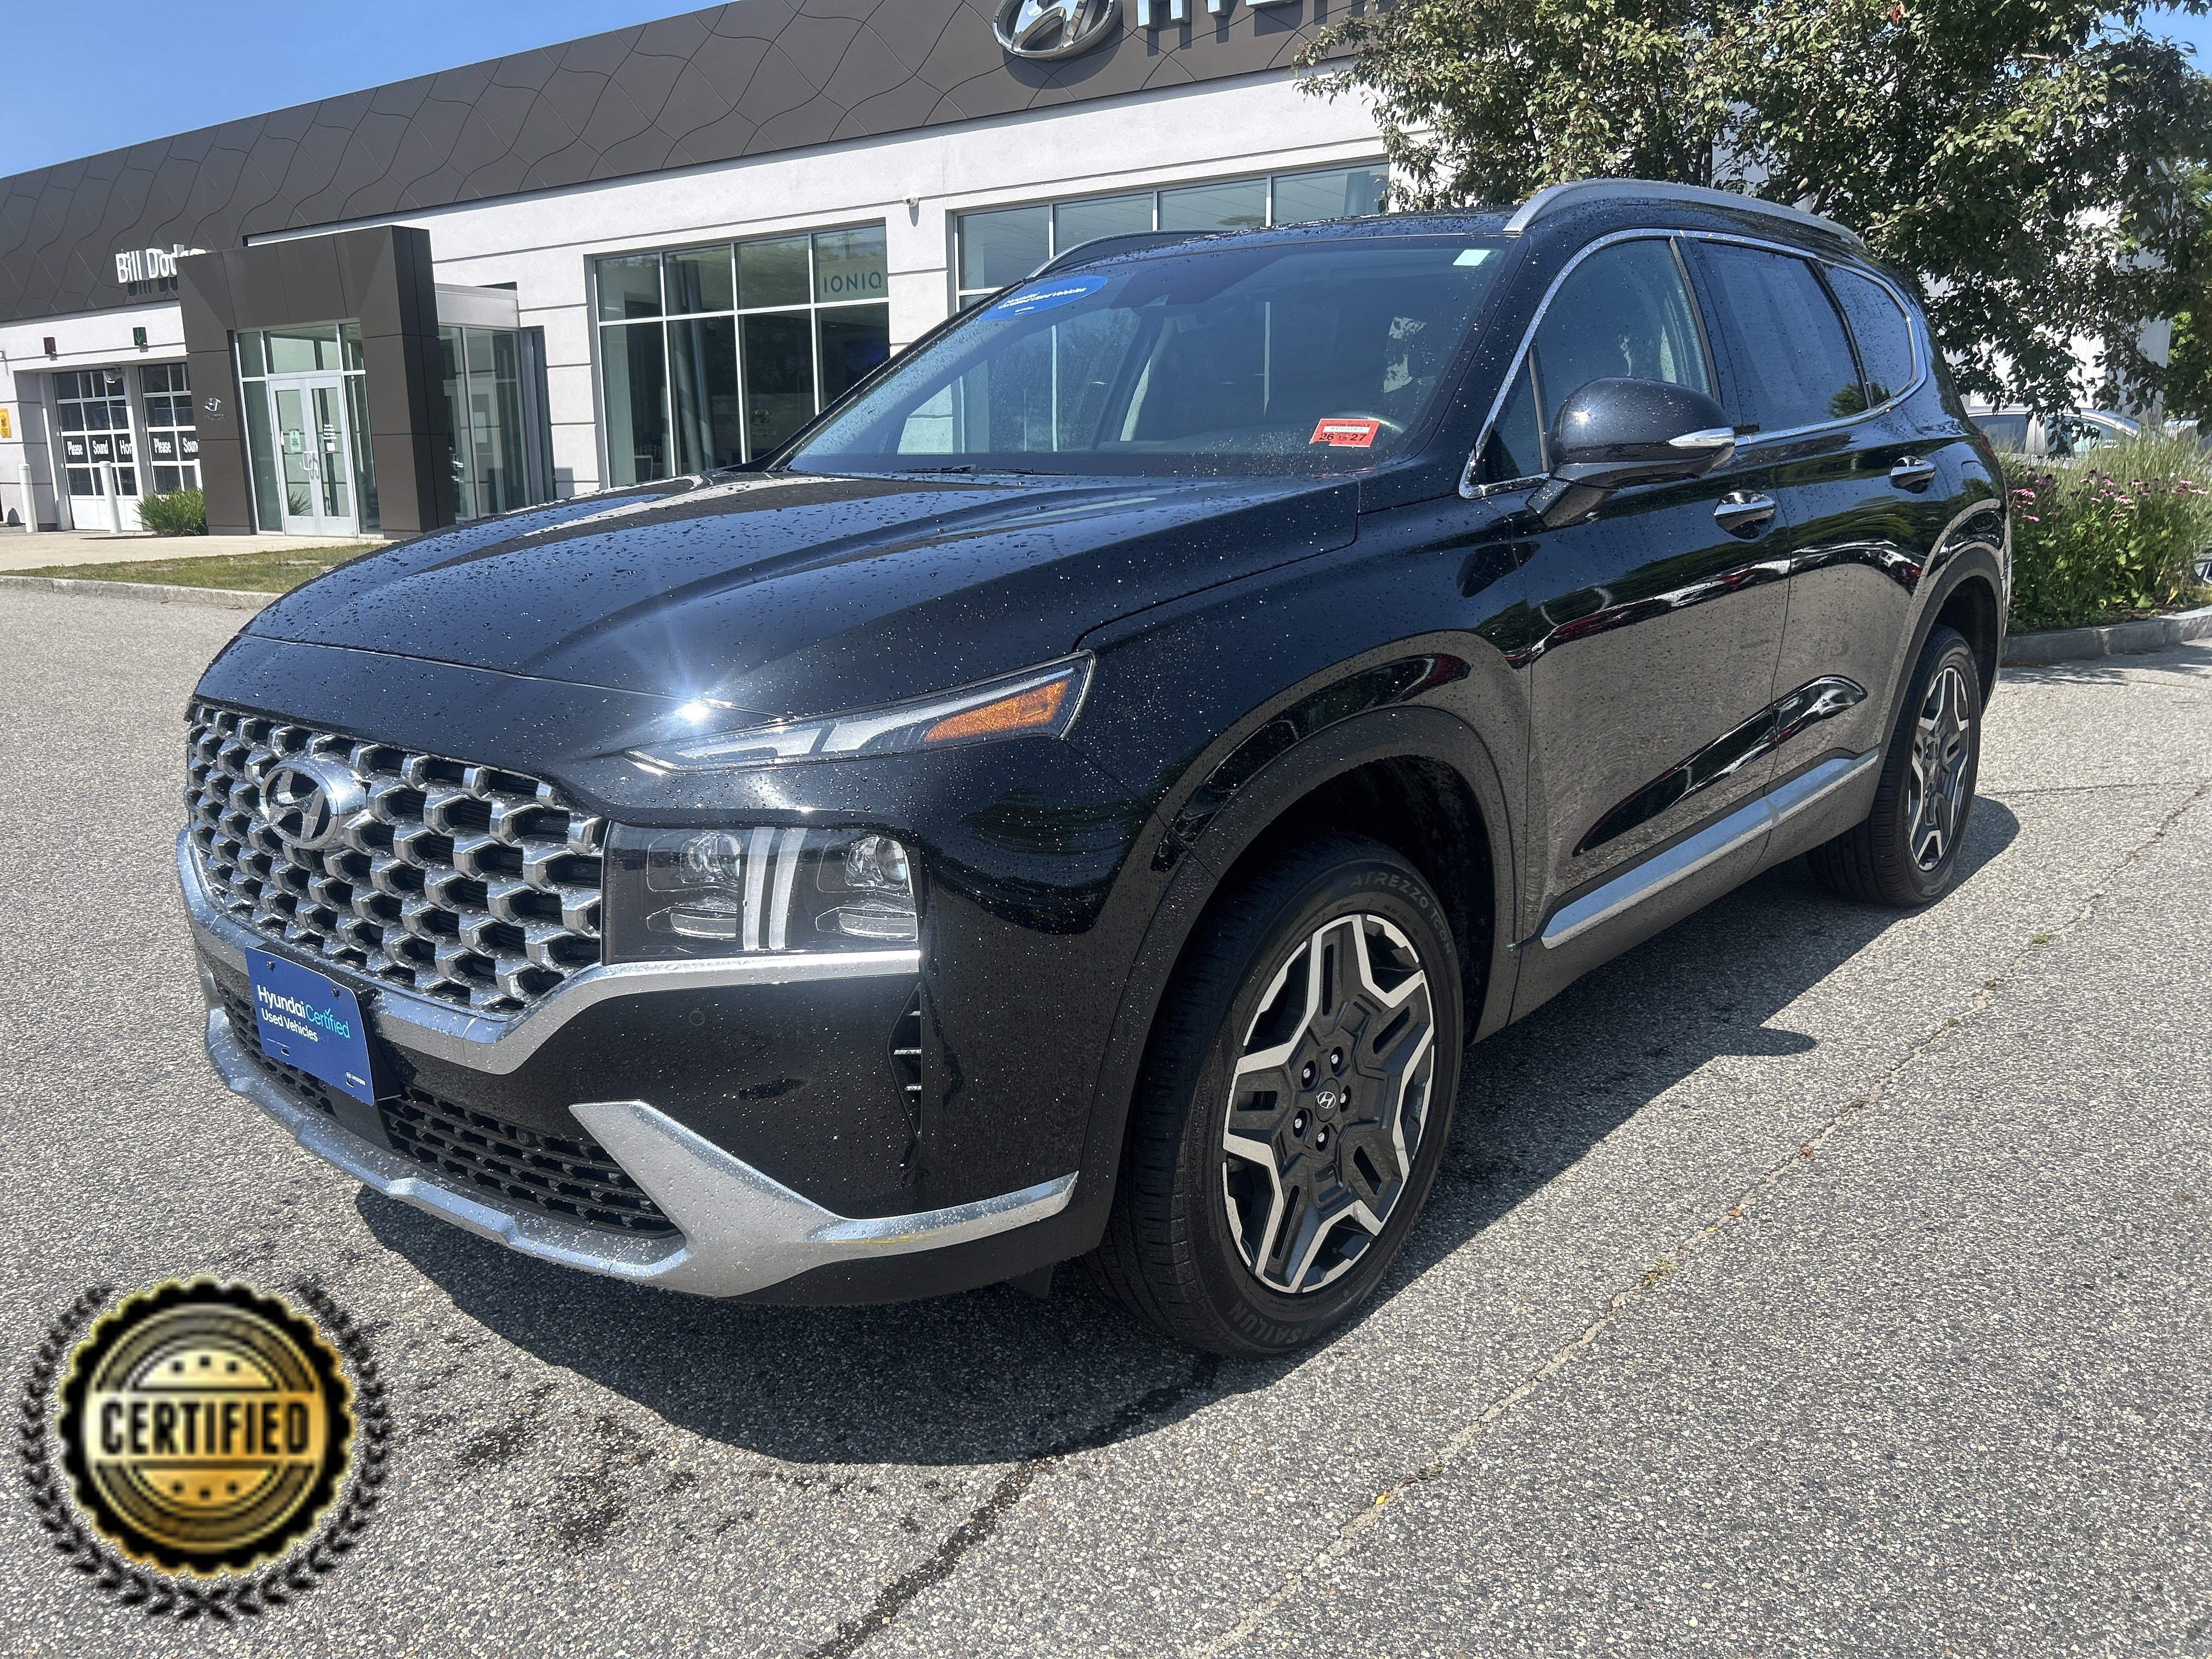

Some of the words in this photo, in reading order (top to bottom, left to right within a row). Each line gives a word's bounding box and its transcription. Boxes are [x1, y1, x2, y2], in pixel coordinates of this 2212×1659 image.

[115, 250, 143, 283] Bill
[145, 244, 207, 279] Dod
[824, 272, 881, 293] IONIQ
[67, 441, 83, 455] Please
[92, 439, 109, 455] Sound
[154, 438, 171, 453] Please
[183, 437, 199, 453] Soun
[1350, 433, 1367, 442] 27
[1349, 871, 1429, 909] ATREZZO
[261, 1007, 284, 1027] Used
[283, 1016, 319, 1042] Vehicles
[1227, 1300, 1304, 1344] SAILUN
